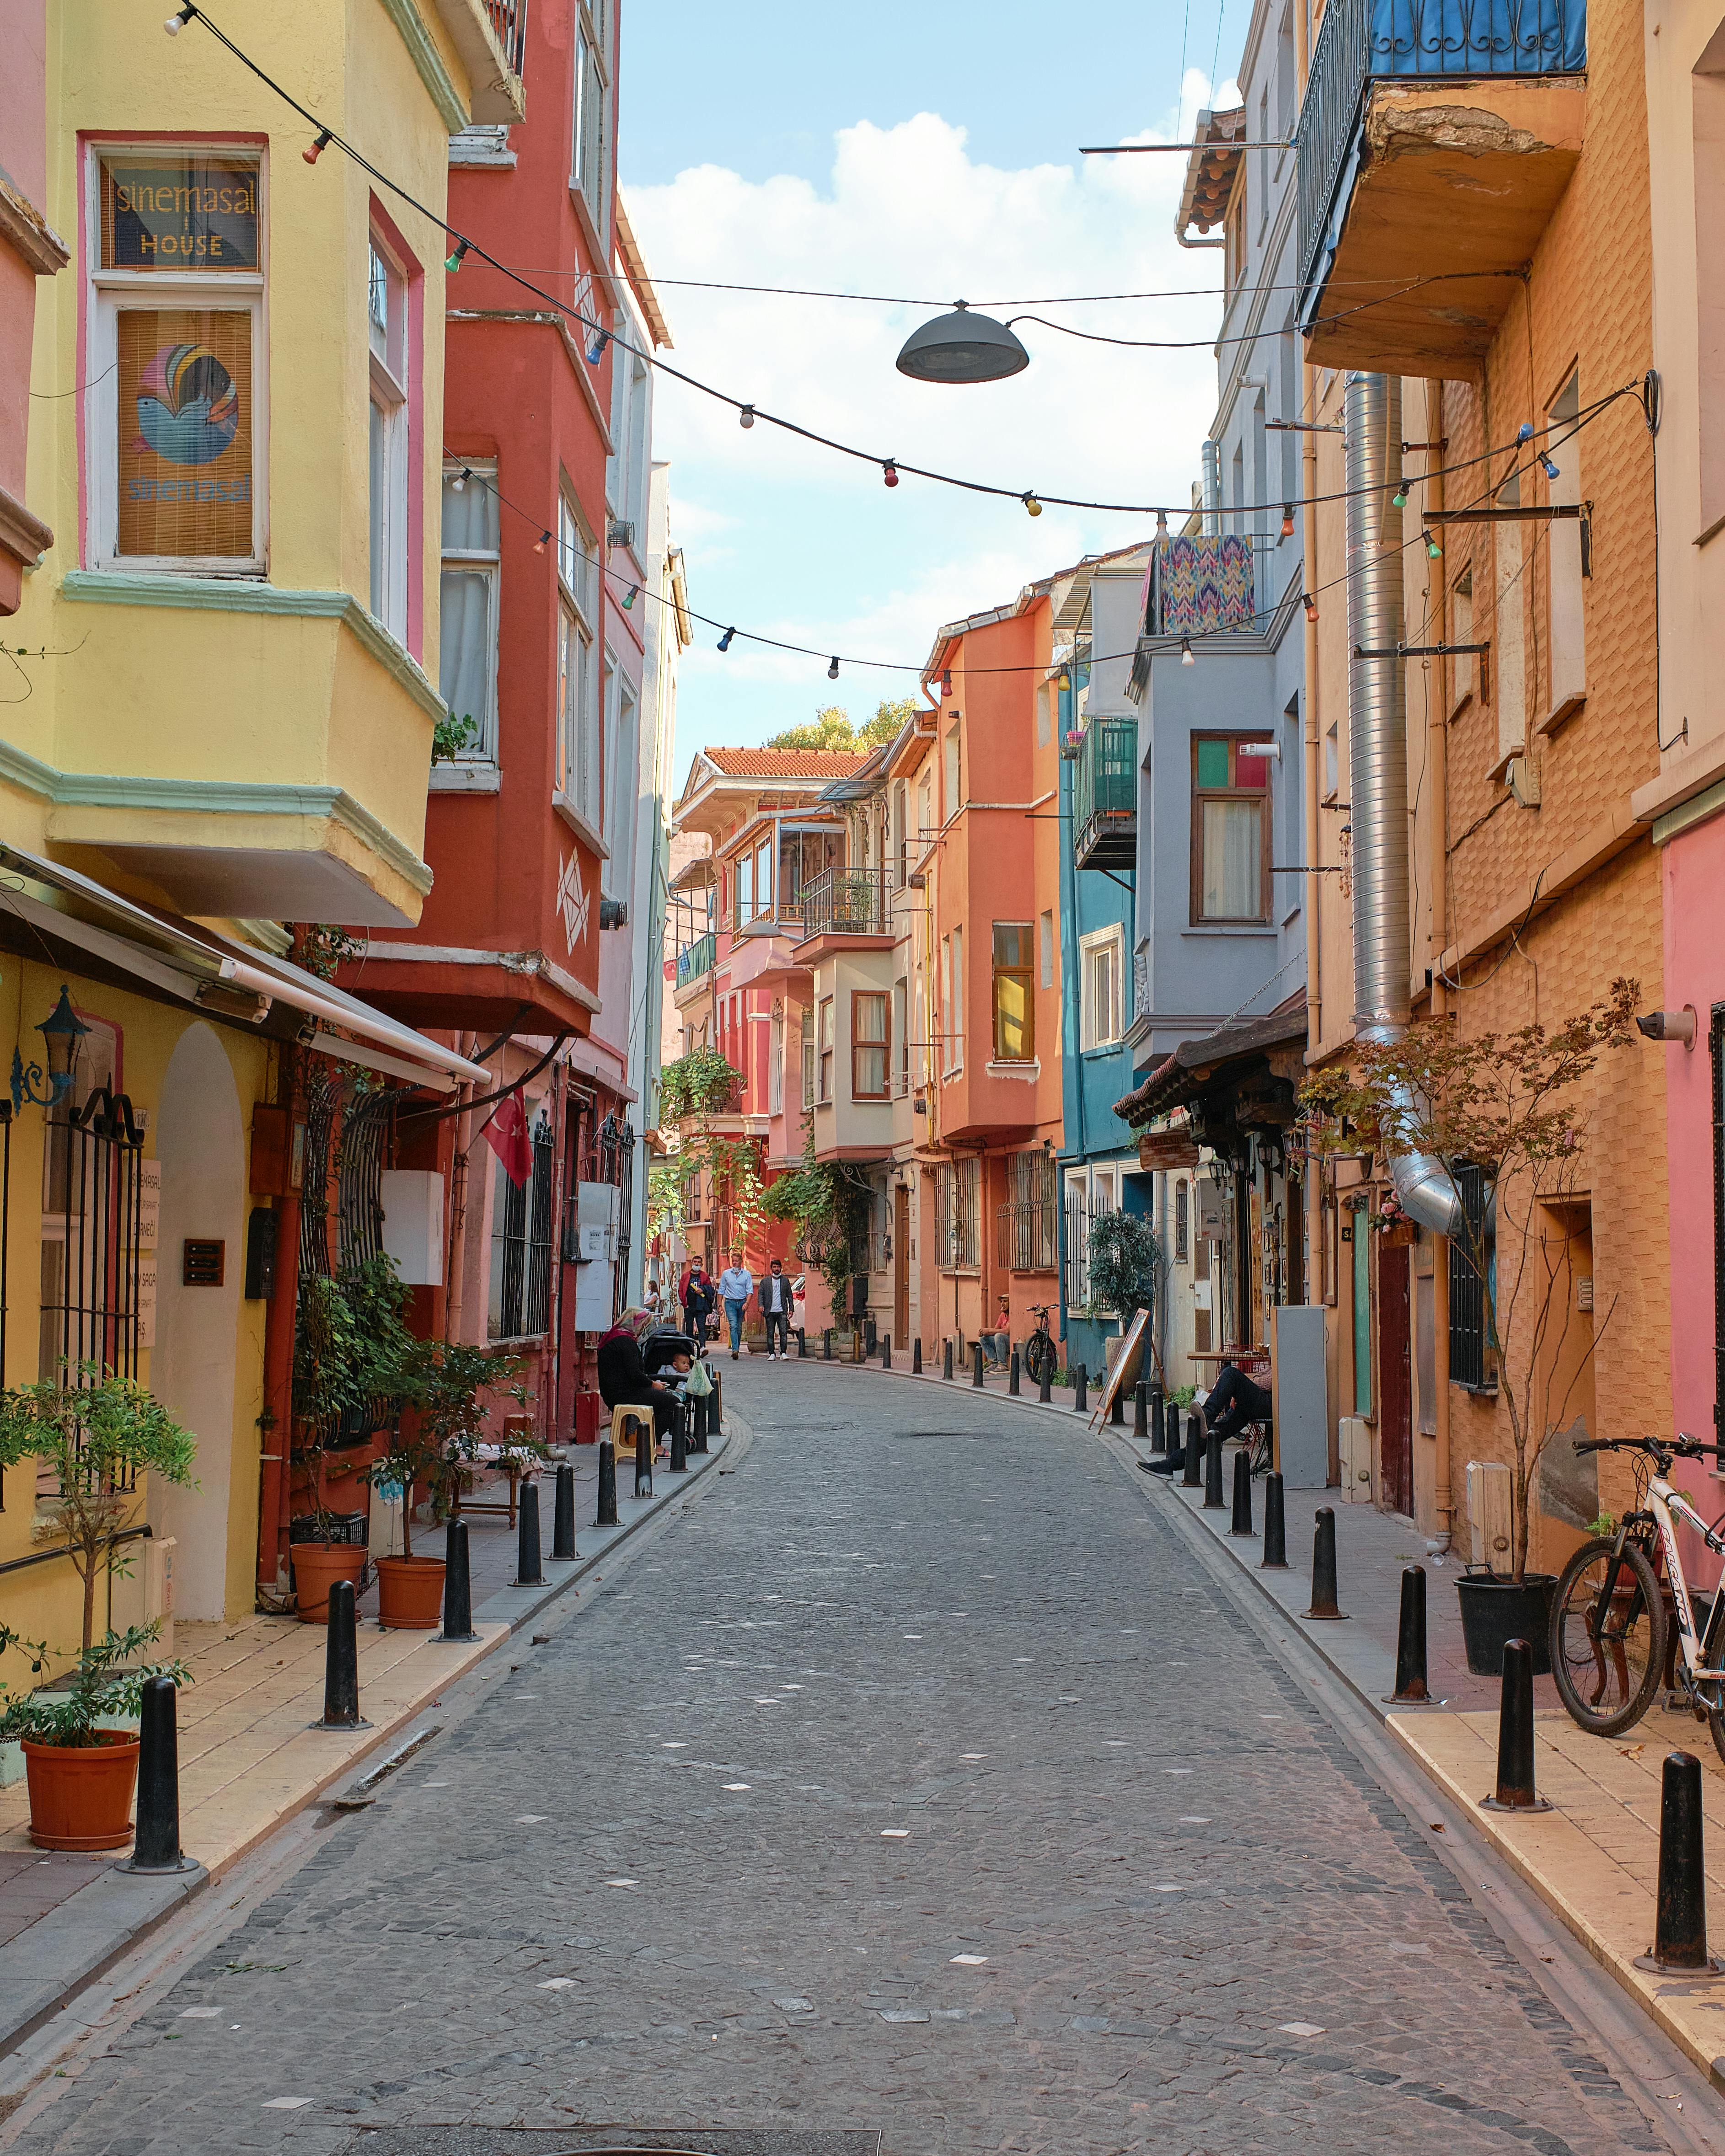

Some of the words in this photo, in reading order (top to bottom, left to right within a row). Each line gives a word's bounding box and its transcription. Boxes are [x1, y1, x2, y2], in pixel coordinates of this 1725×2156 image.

[117, 179, 255, 214] sinemasal
[141, 235, 222, 256] HOUSE
[129, 473, 251, 502] sinemasal
[134, 1220, 155, 1236] DRNEĞİ
[130, 1273, 141, 1286] NW
[142, 1273, 156, 1287] SAGA
[1661, 1526, 1687, 1625] SALCANO
